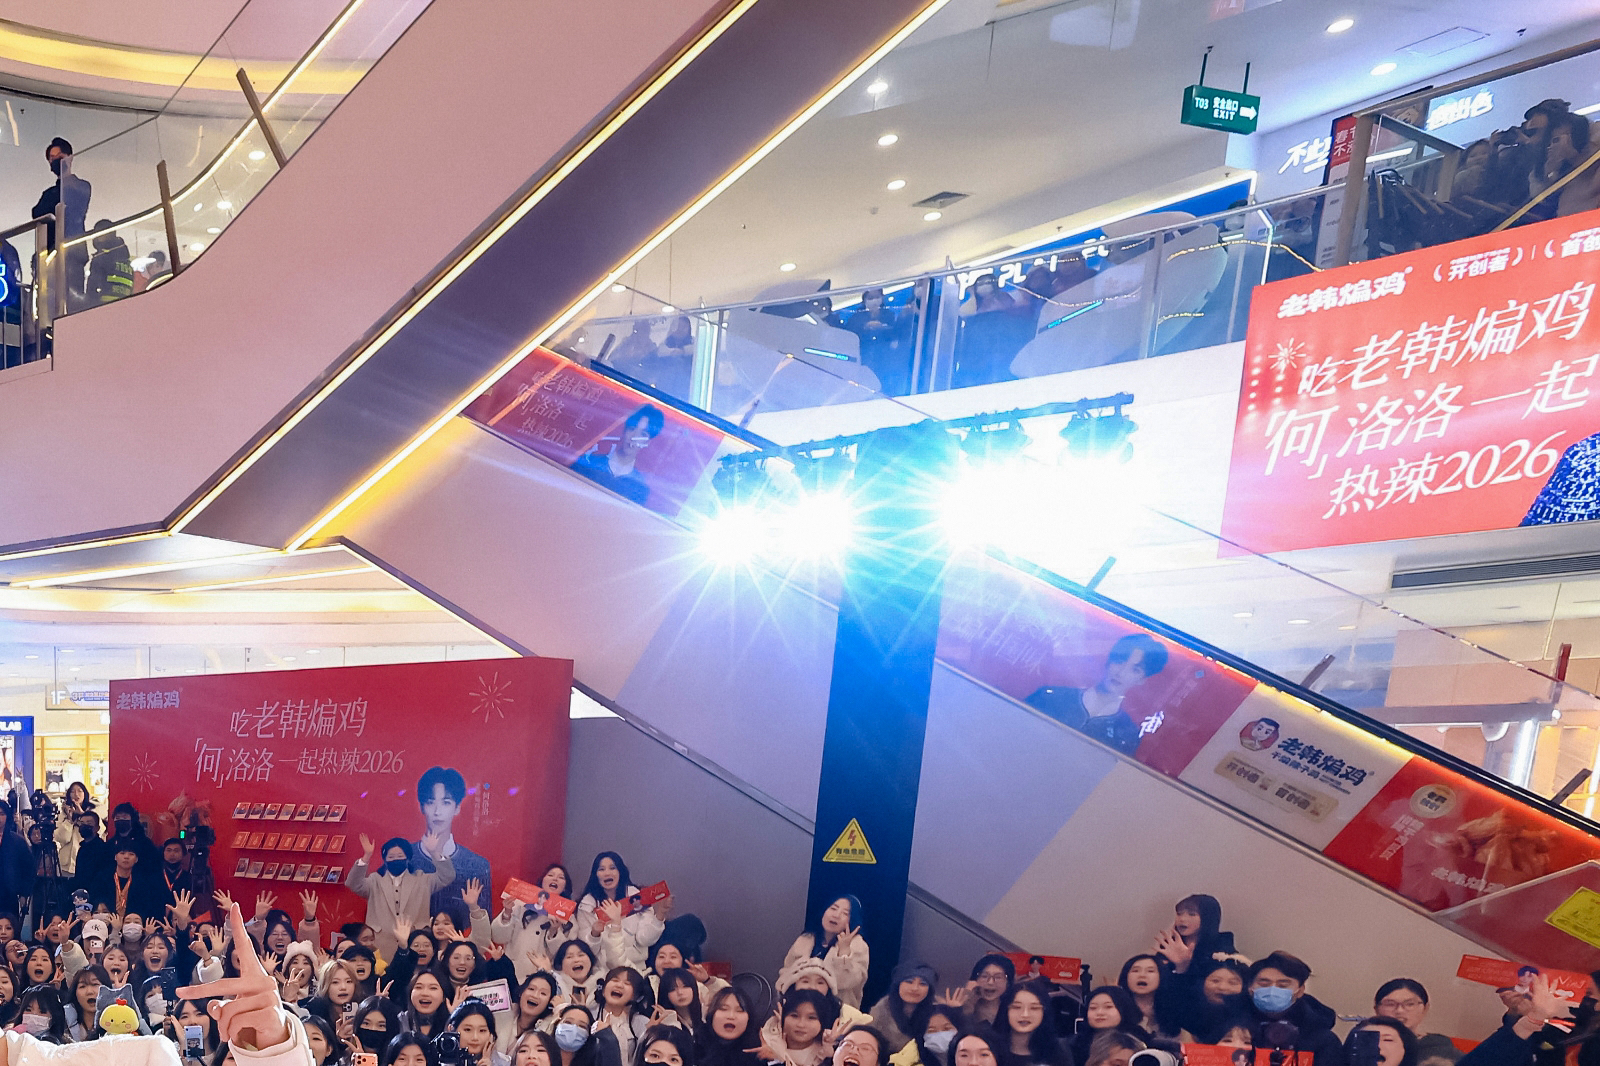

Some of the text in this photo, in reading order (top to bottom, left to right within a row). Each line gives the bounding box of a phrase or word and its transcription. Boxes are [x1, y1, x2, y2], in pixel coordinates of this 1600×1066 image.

[1195, 97, 1209, 110] T03
[1213, 96, 1239, 112] 安全出口
[1213, 109, 1235, 121] EXIT
[1448, 251, 1510, 281] 开创者
[1277, 271, 1406, 318] 老韩煸鸡
[1297, 280, 1596, 398] 吃老韩煸鸡
[1321, 430, 1566, 519] 热辣2026
[116, 690, 180, 710] 老韩煸鸡
[230, 697, 368, 740] 吃老韩煸鸡
[1278, 737, 1368, 786] 老韩煸鸡
